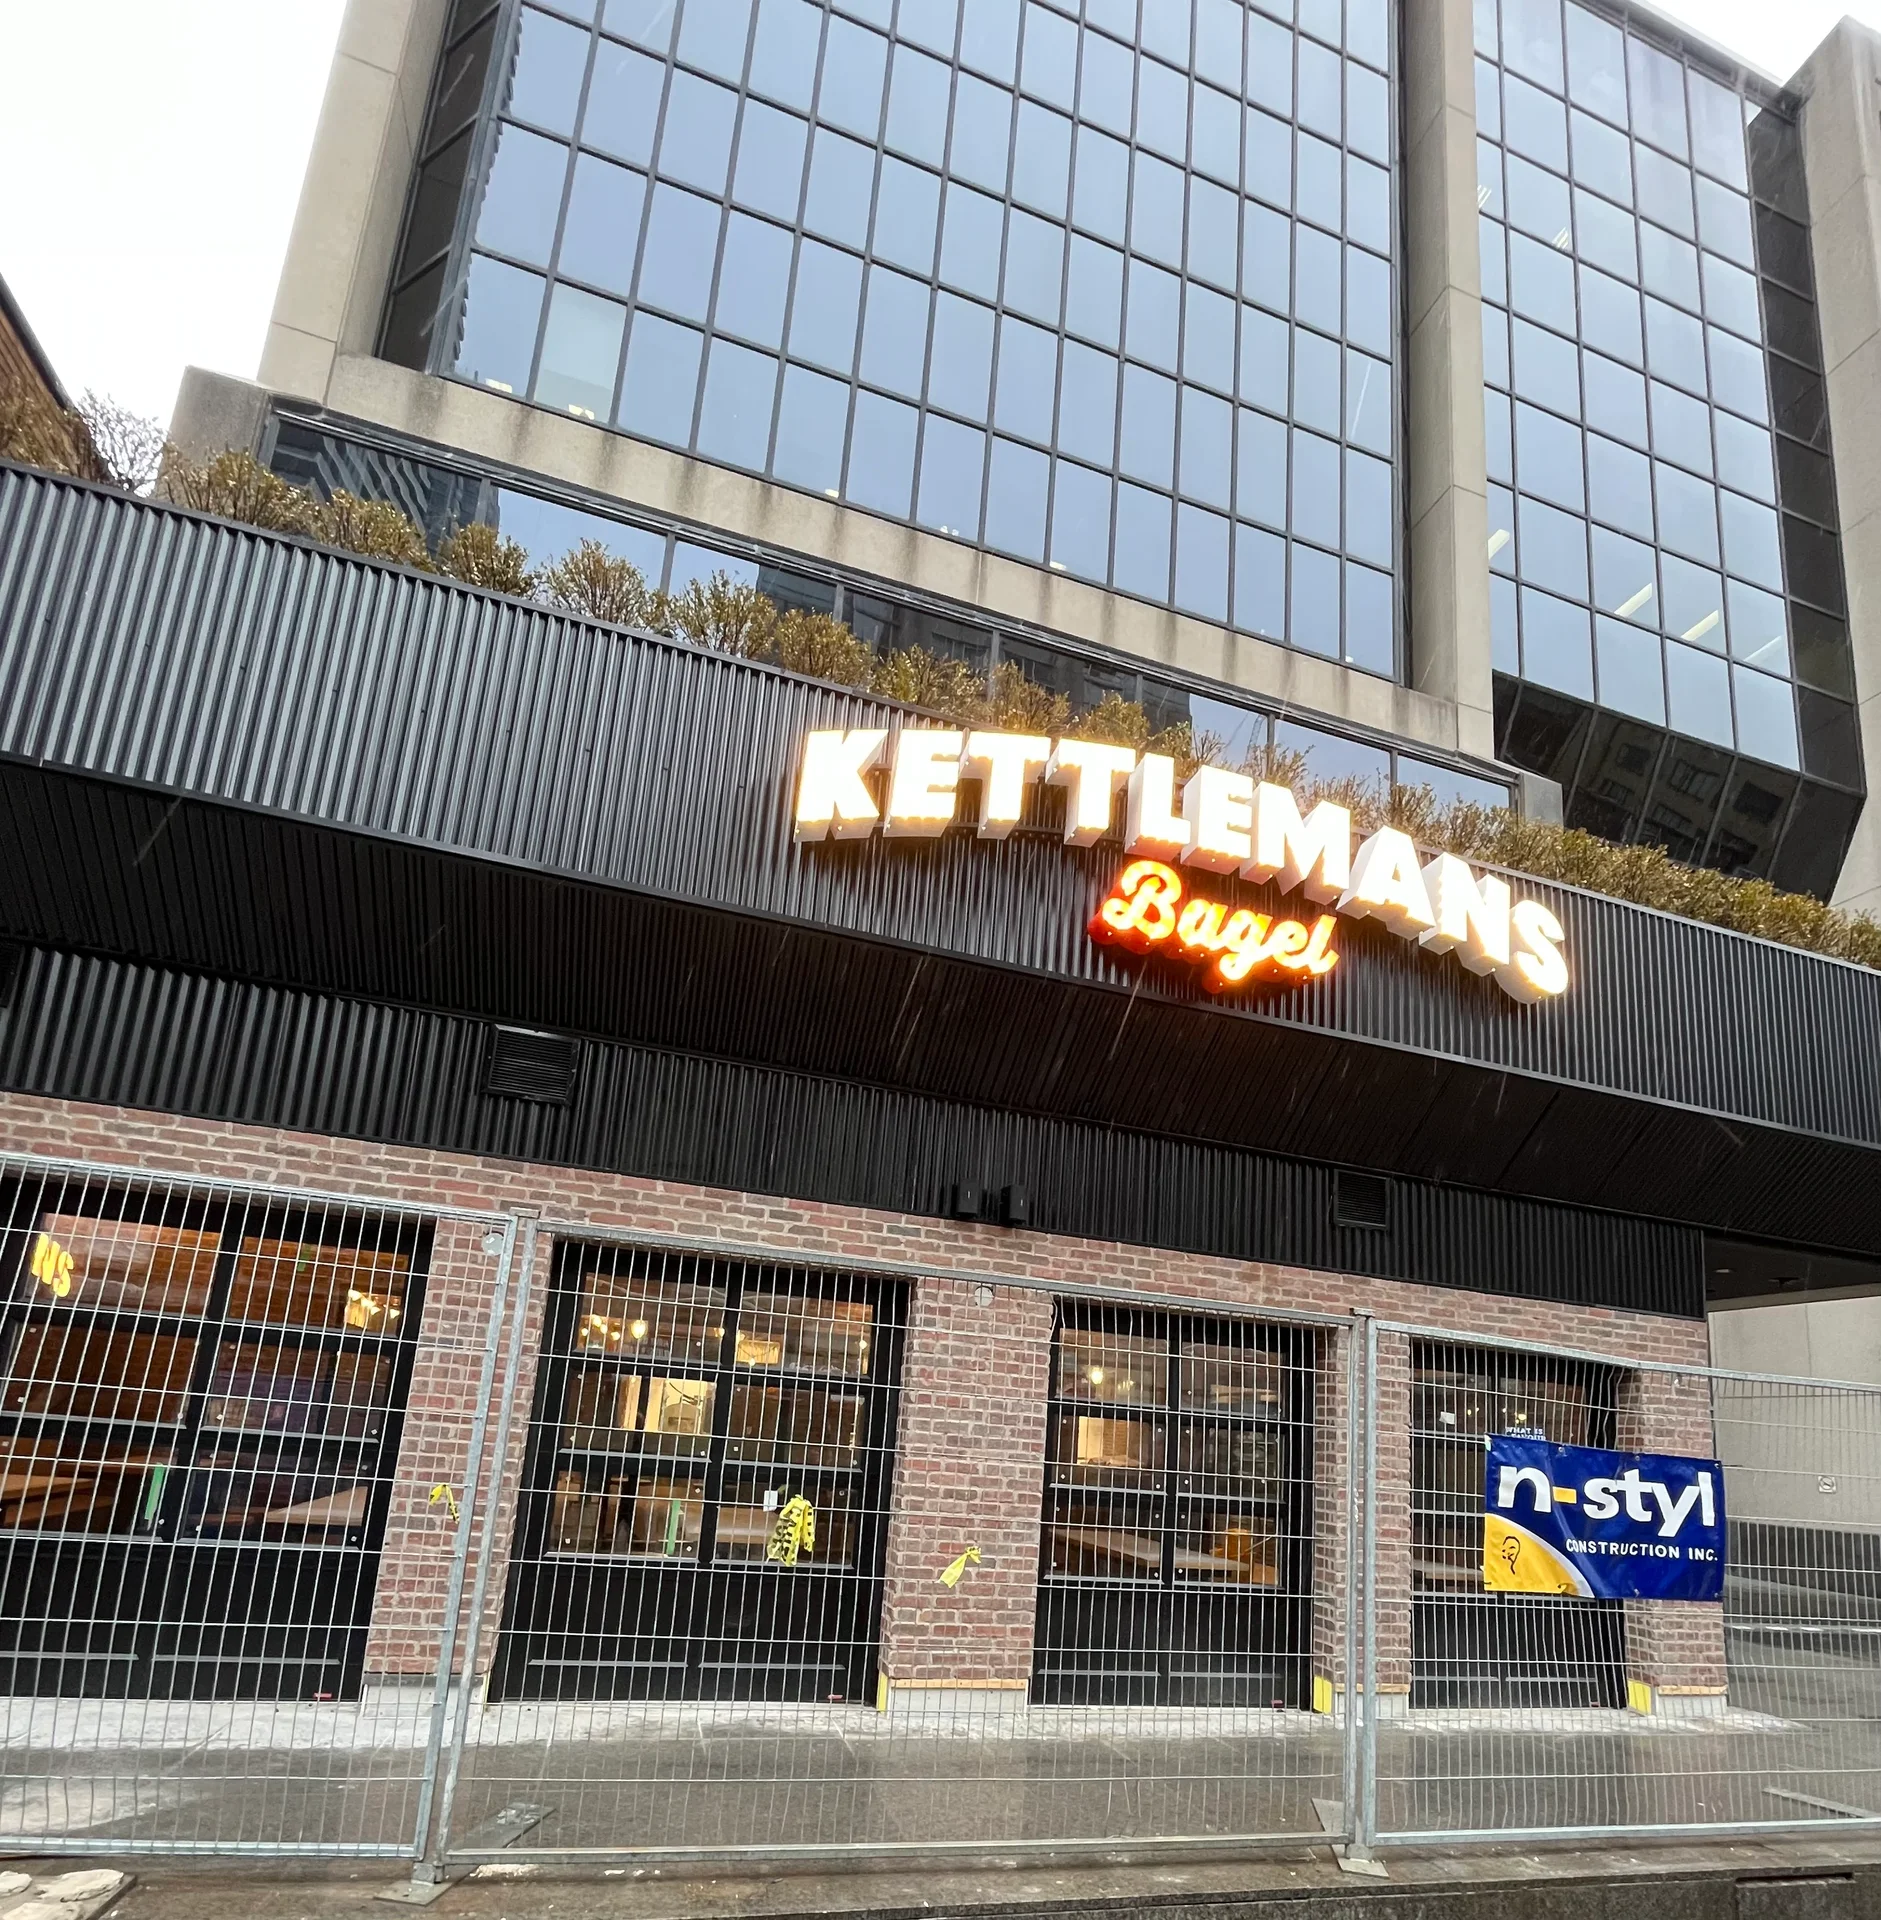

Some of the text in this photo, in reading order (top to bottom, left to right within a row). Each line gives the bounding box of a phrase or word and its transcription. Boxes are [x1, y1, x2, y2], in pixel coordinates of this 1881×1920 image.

[798, 728, 1569, 1000] KETTLEMANS
[1098, 859, 1341, 982] Bagel
[1497, 1465, 1715, 1537] n-styl
[1566, 1538, 1718, 1561] CONSTRUCTION INC.
